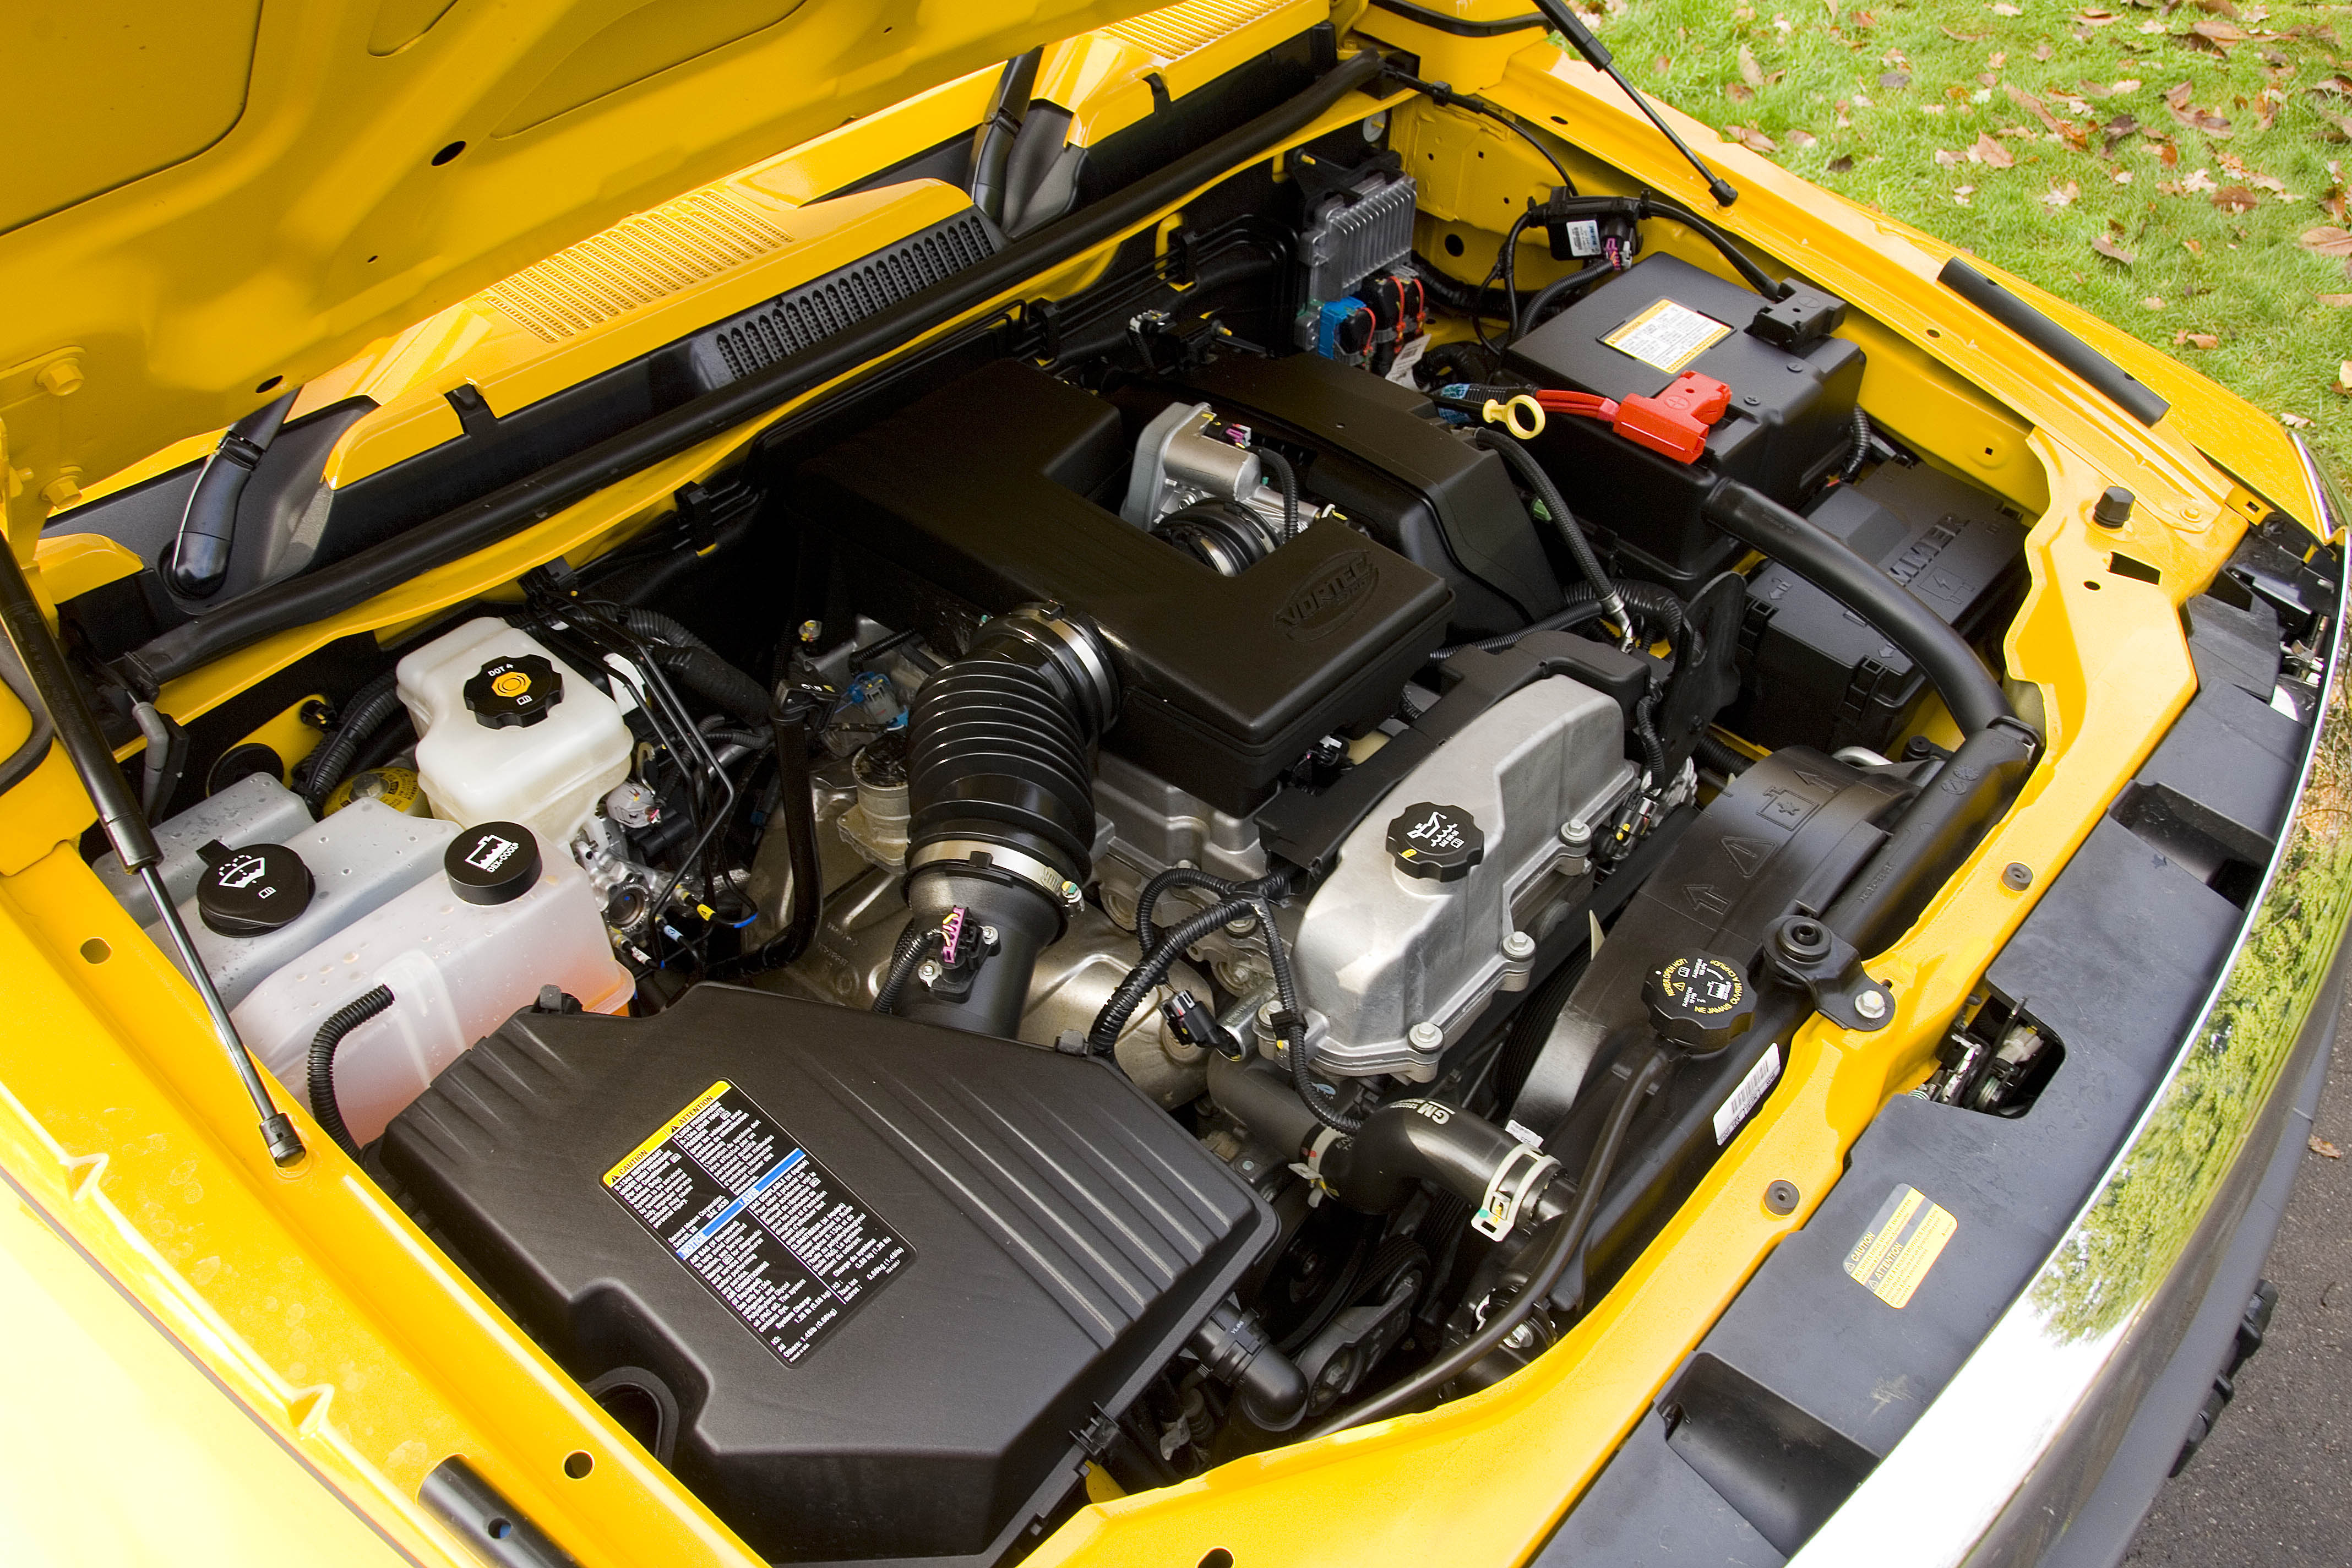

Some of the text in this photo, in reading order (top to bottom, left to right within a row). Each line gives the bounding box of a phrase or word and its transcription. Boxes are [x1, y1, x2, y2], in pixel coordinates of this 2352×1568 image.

[1887, 512, 1969, 587] MMER
[1275, 554, 1371, 625] VORTEC
[487, 661, 514, 677] DOT 4
[1663, 965, 1676, 977] OPEN
[677, 1095, 714, 1125] ATTENTION
[1417, 1103, 1449, 1124] GM
[618, 1150, 649, 1174] CAUTION
[741, 1187, 760, 1204] AVIS
[680, 1232, 707, 1256] NOTICE
[1850, 1231, 1876, 1262] CAUTION
[1875, 1242, 1903, 1280] ATTENTION
